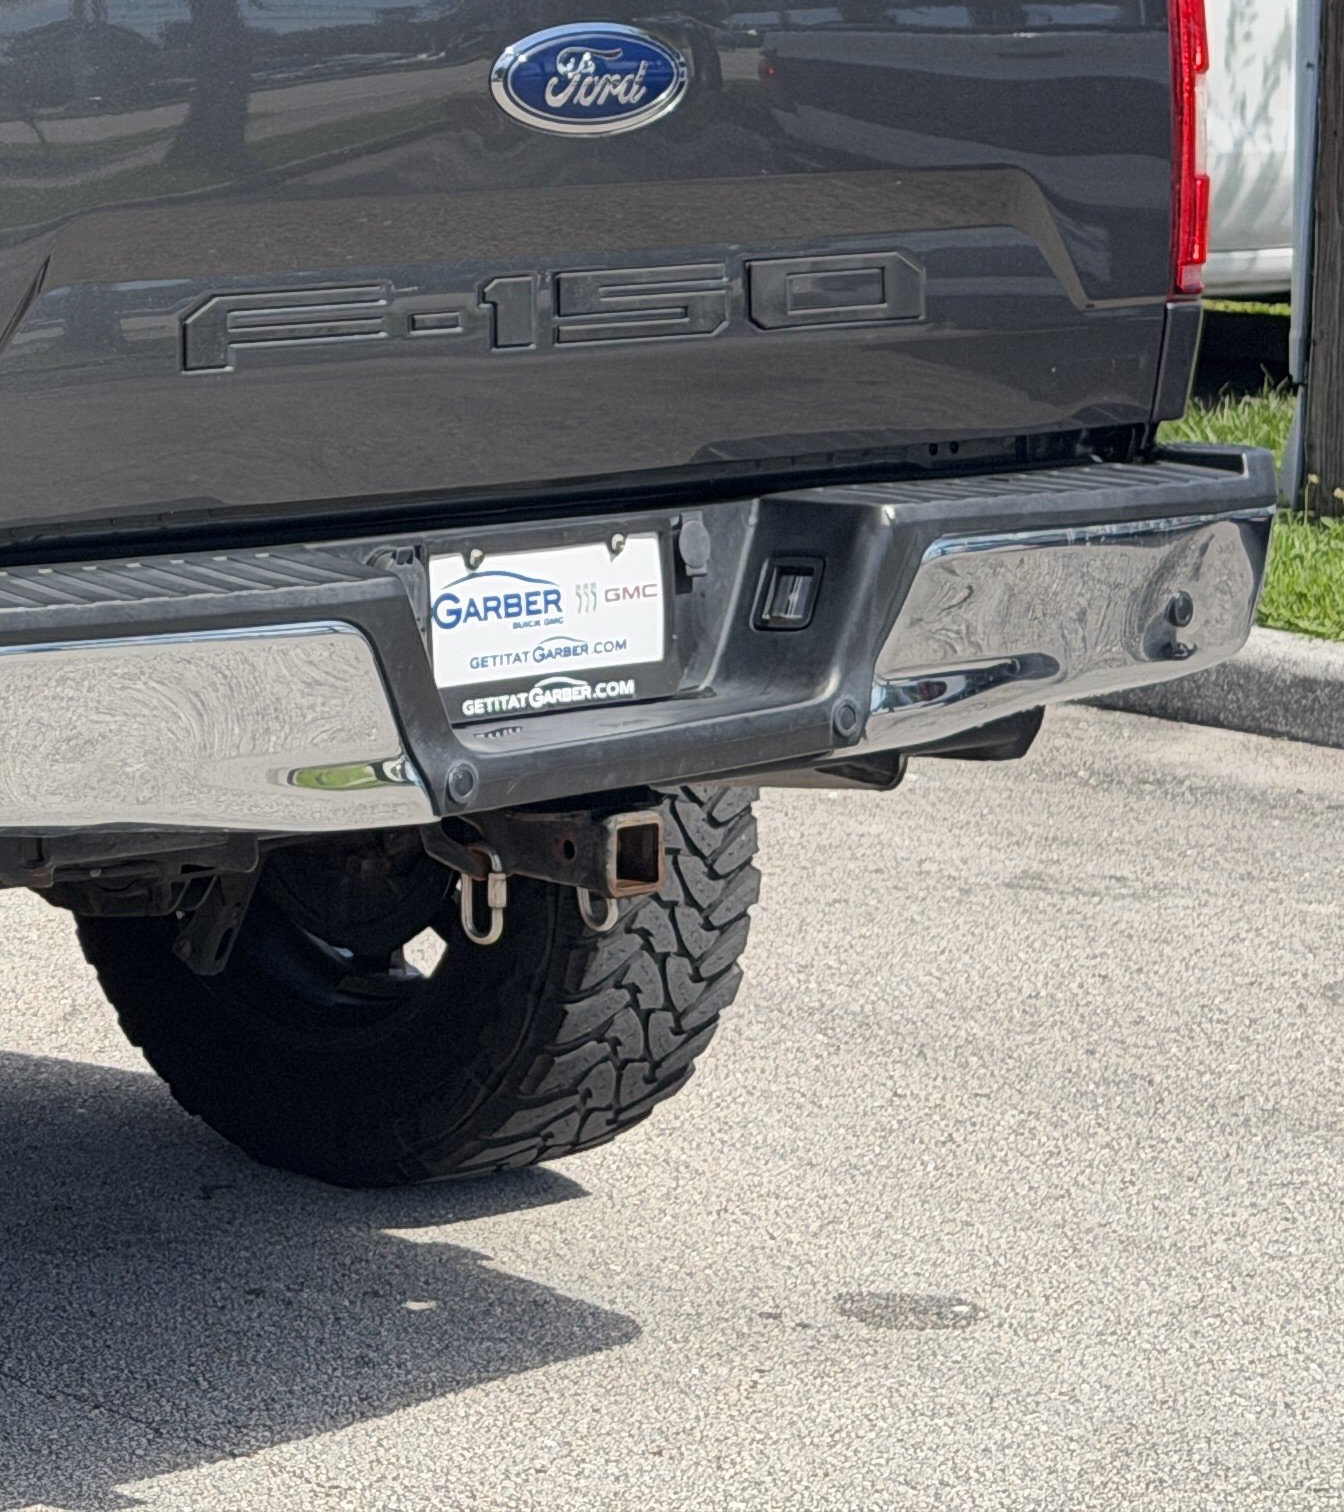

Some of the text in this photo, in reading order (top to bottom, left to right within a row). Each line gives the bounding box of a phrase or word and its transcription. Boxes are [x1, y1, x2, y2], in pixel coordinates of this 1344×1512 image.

[545, 47, 649, 107] Ford
[178, 252, 927, 375] F-150
[432, 589, 563, 629] GARBER
[604, 583, 658, 603] GMC
